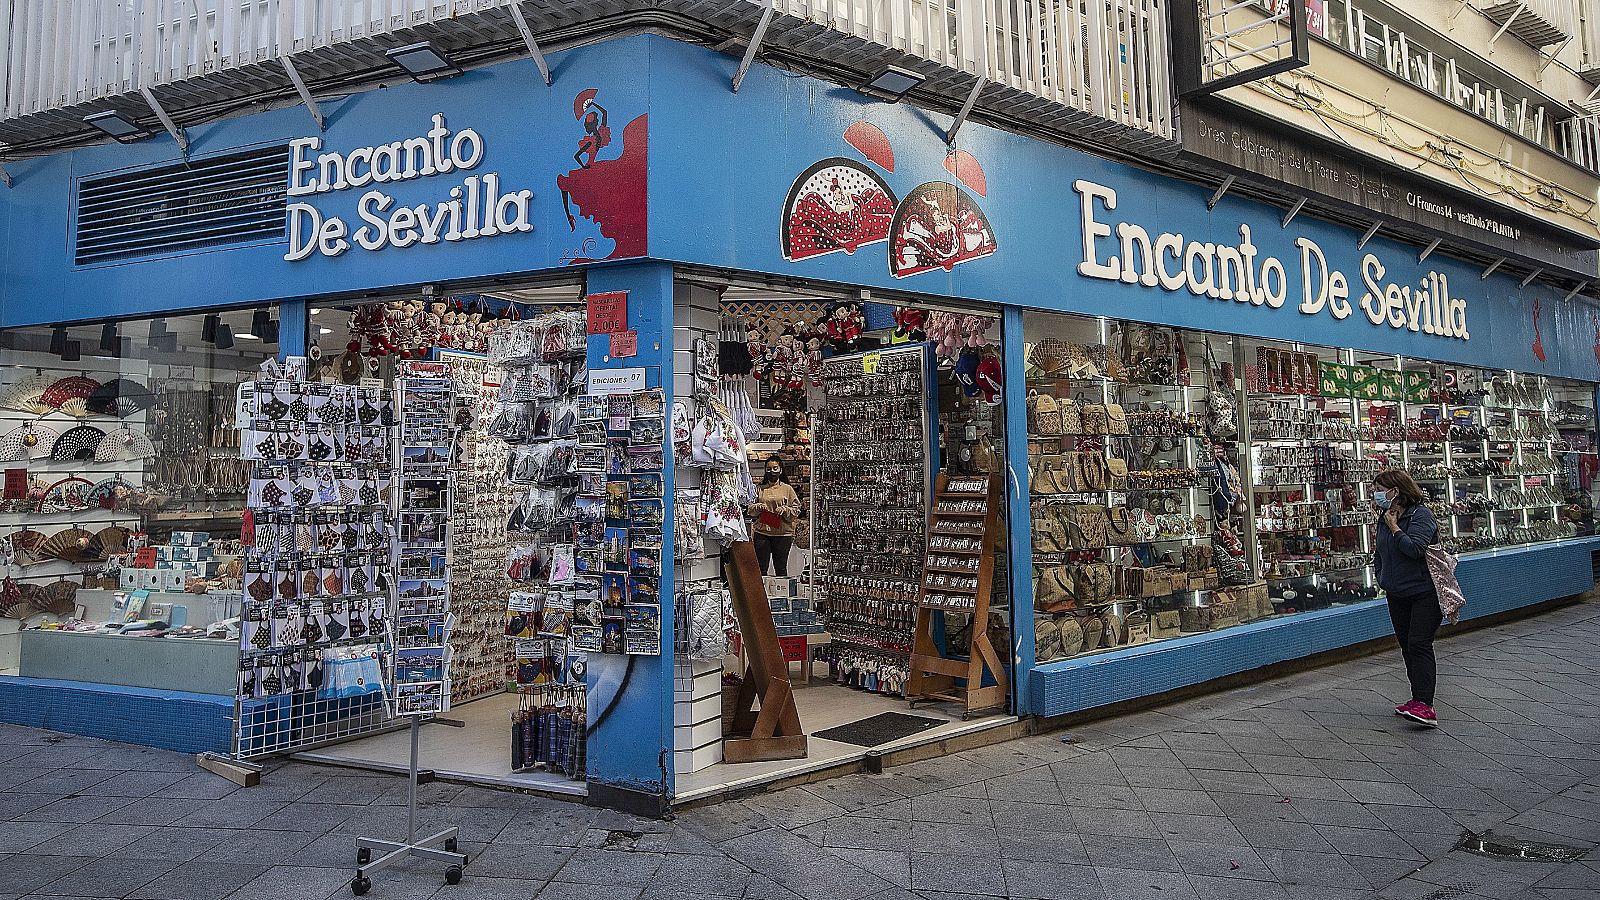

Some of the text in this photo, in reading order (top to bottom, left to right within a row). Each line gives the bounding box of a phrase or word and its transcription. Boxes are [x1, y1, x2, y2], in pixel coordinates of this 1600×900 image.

[1313, 12, 1322, 31] 341
[286, 113, 484, 196] Encanto
[1199, 119, 1229, 145] Dres.
[1231, 131, 1276, 161] Cabrera
[1278, 151, 1286, 168] y
[1288, 153, 1302, 169] de
[1304, 156, 1313, 173] la
[1314, 159, 1339, 182] Torre
[283, 201, 350, 261] De
[353, 172, 534, 250] Sevilla
[1406, 192, 1416, 207] C/
[1417, 195, 1444, 215] Francos
[1445, 205, 1453, 219] 14
[1493, 221, 1514, 238] PLANTA
[1072, 179, 1471, 341] Encanto De Sevilla
[592, 320, 619, 333] 2,00€
[631, 373, 641, 381] 07
